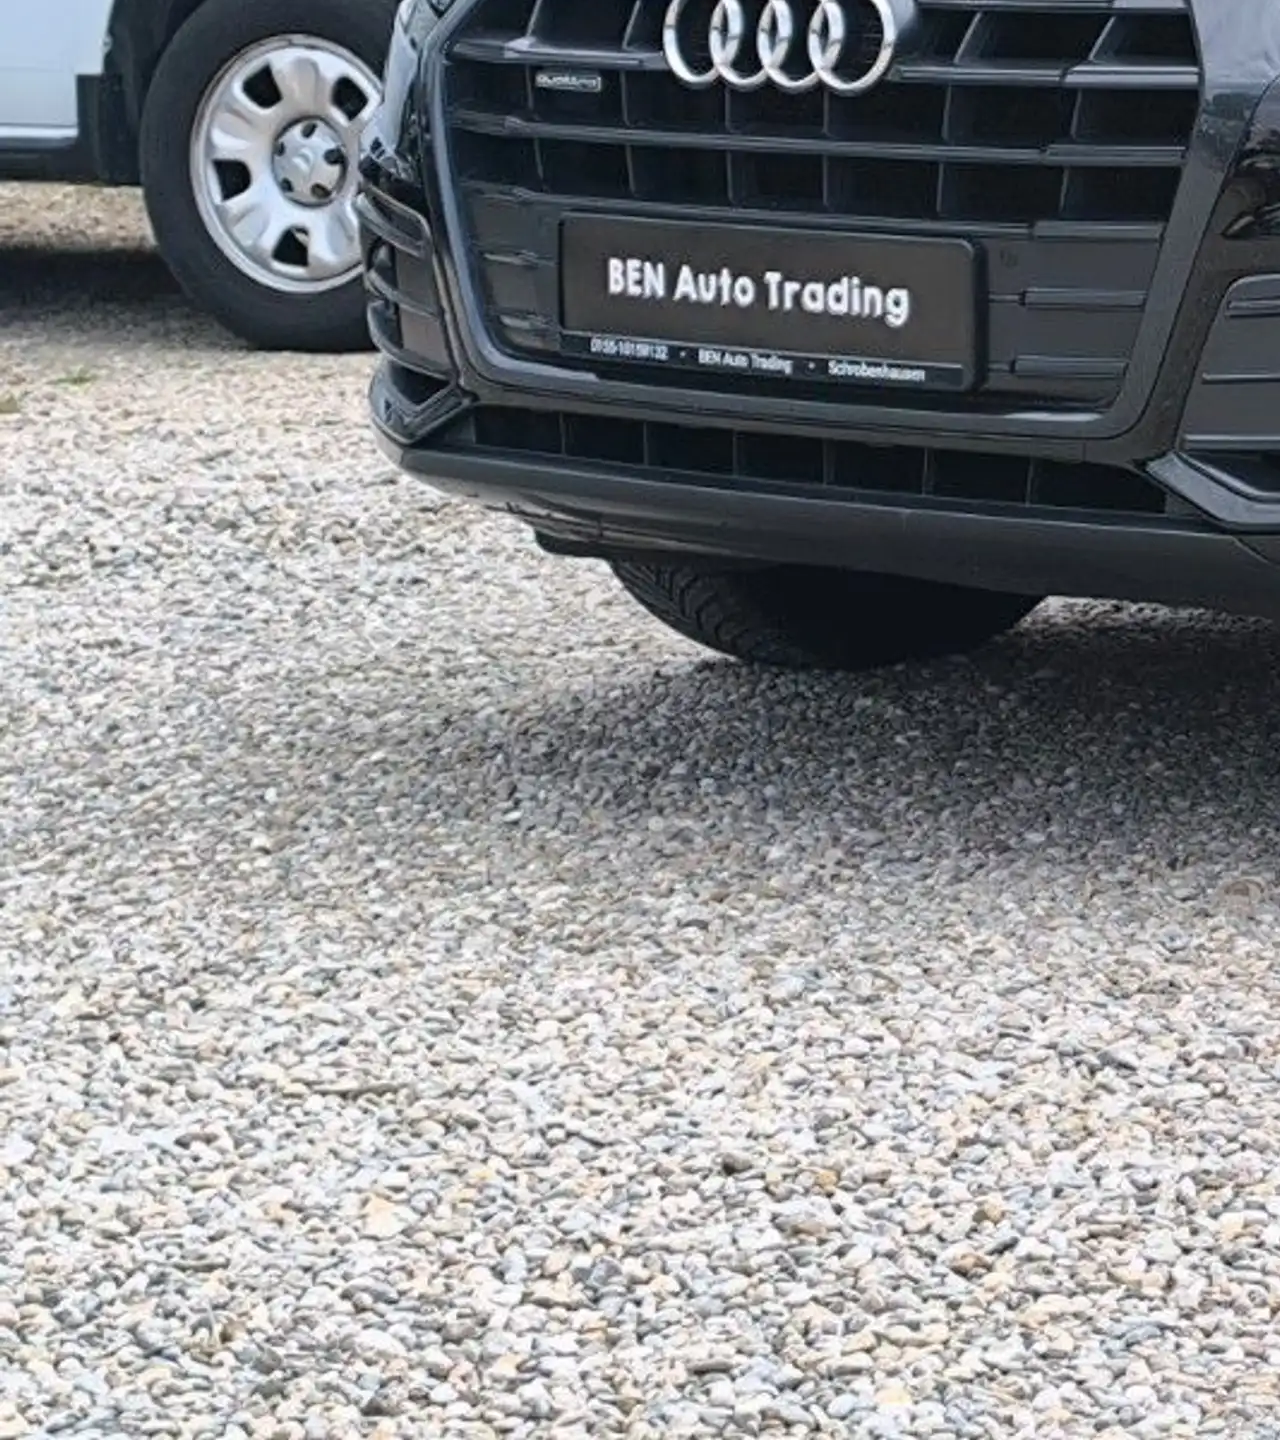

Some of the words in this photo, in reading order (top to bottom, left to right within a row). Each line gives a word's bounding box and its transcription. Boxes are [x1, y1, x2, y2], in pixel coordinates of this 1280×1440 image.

[608, 257, 666, 300] BEN
[672, 264, 755, 308] Auto
[764, 271, 910, 328] Trading
[698, 348, 722, 365] BEN
[722, 352, 749, 369] Auto
[750, 352, 793, 376] Trading
